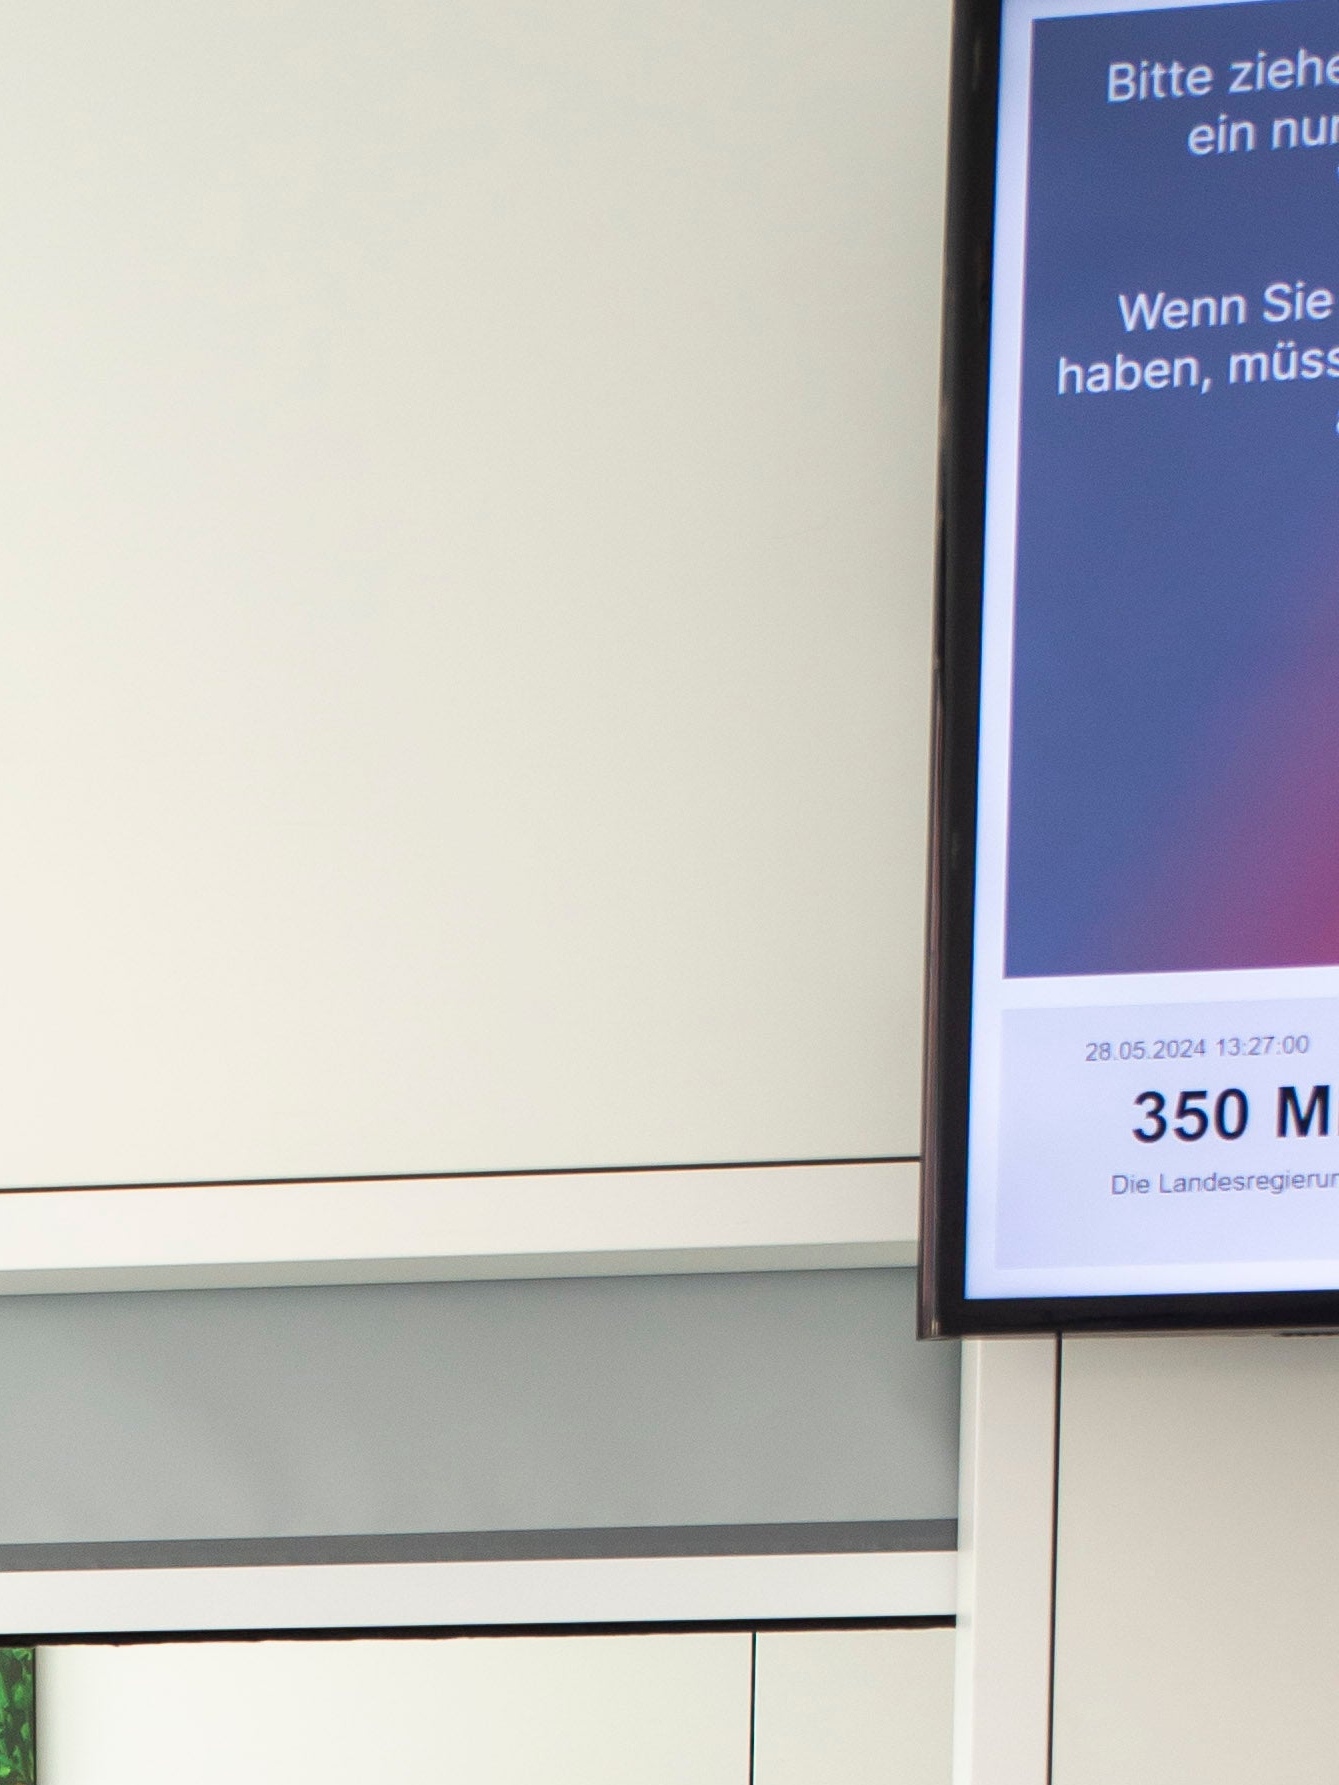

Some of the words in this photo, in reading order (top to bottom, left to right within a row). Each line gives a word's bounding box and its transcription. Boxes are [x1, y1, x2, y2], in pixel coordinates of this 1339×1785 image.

[1107, 60, 1213, 102] Bitte
[1187, 113, 1255, 155] ein
[1118, 291, 1247, 332] Wenn
[1262, 280, 1334, 323] Sie
[1057, 353, 1212, 395] haben,
[1085, 1038, 1207, 1062] 28.05.2024
[1216, 1034, 1310, 1057] 13:27:00
[1131, 1087, 1249, 1143] 350
[1111, 1174, 1151, 1196] Die
